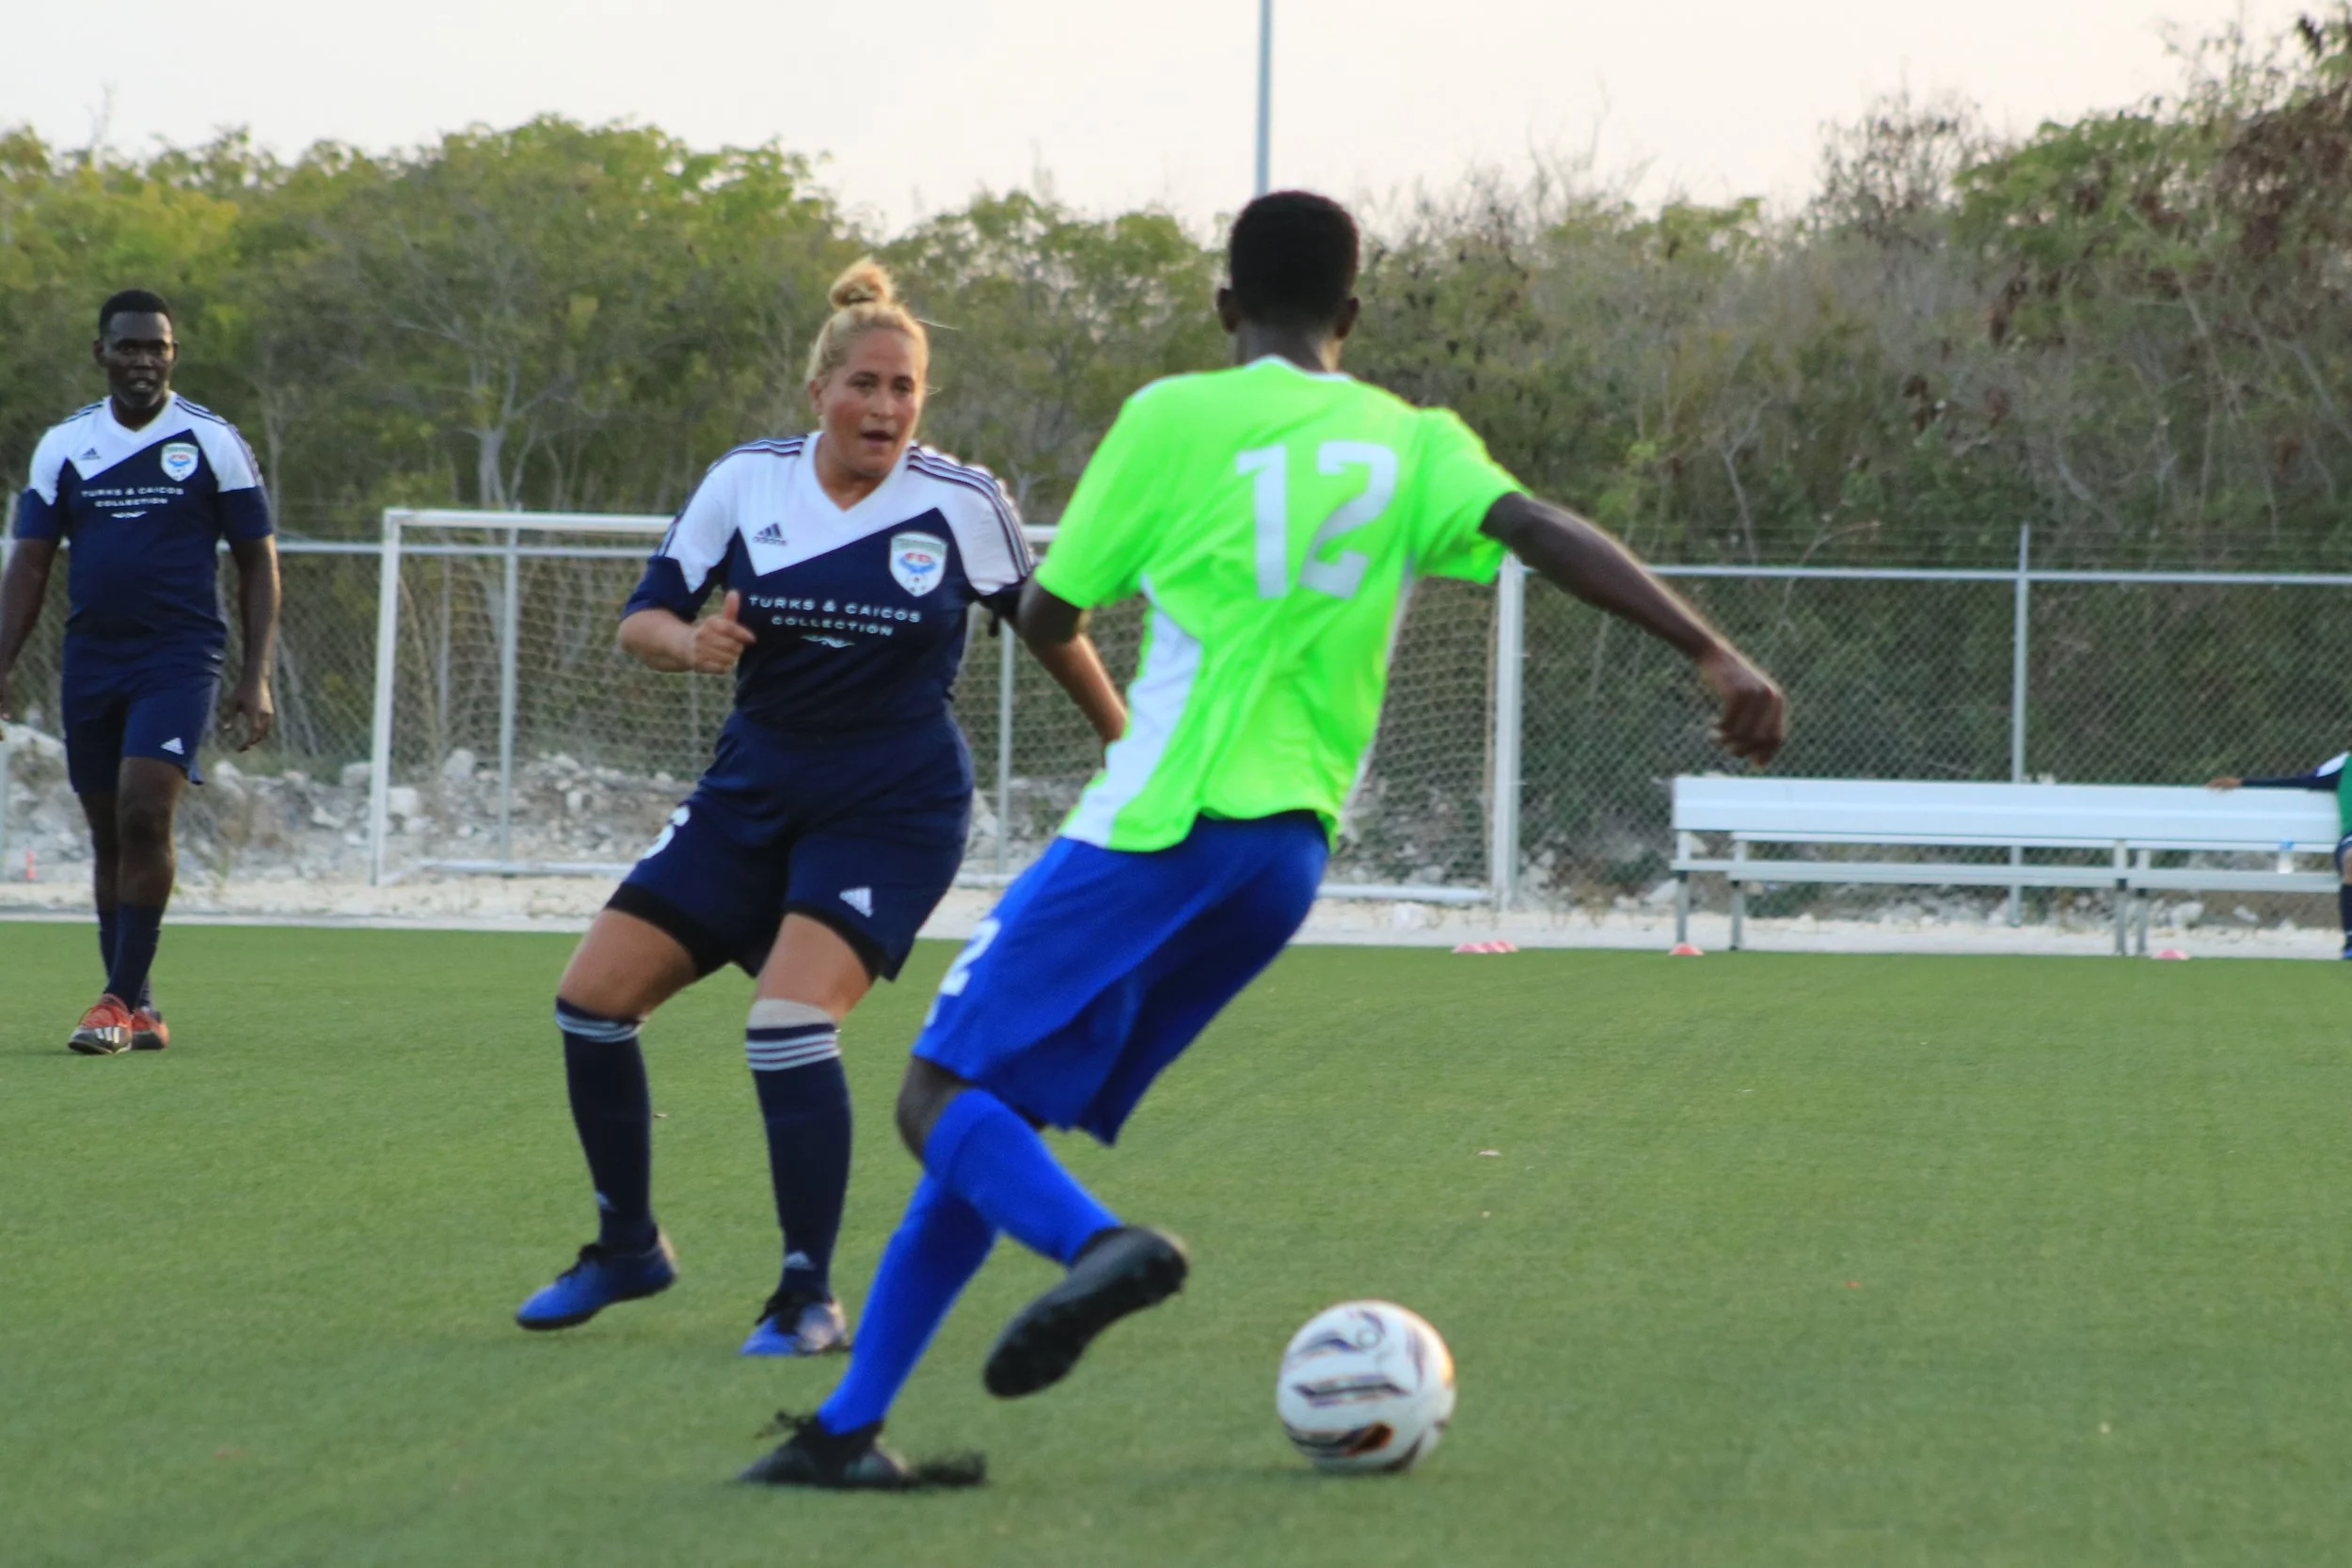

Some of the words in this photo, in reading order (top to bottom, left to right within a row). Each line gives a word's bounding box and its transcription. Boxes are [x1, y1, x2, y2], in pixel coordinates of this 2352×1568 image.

[81, 488, 122, 498] TURKS
[125, 487, 135, 496] &
[94, 497, 168, 507] COLLECTION
[1234, 439, 1398, 600] 12
[749, 594, 816, 611] TURKS
[822, 598, 836, 612] &
[845, 601, 922, 623] CAICOS
[771, 614, 894, 637] COLLECTION
